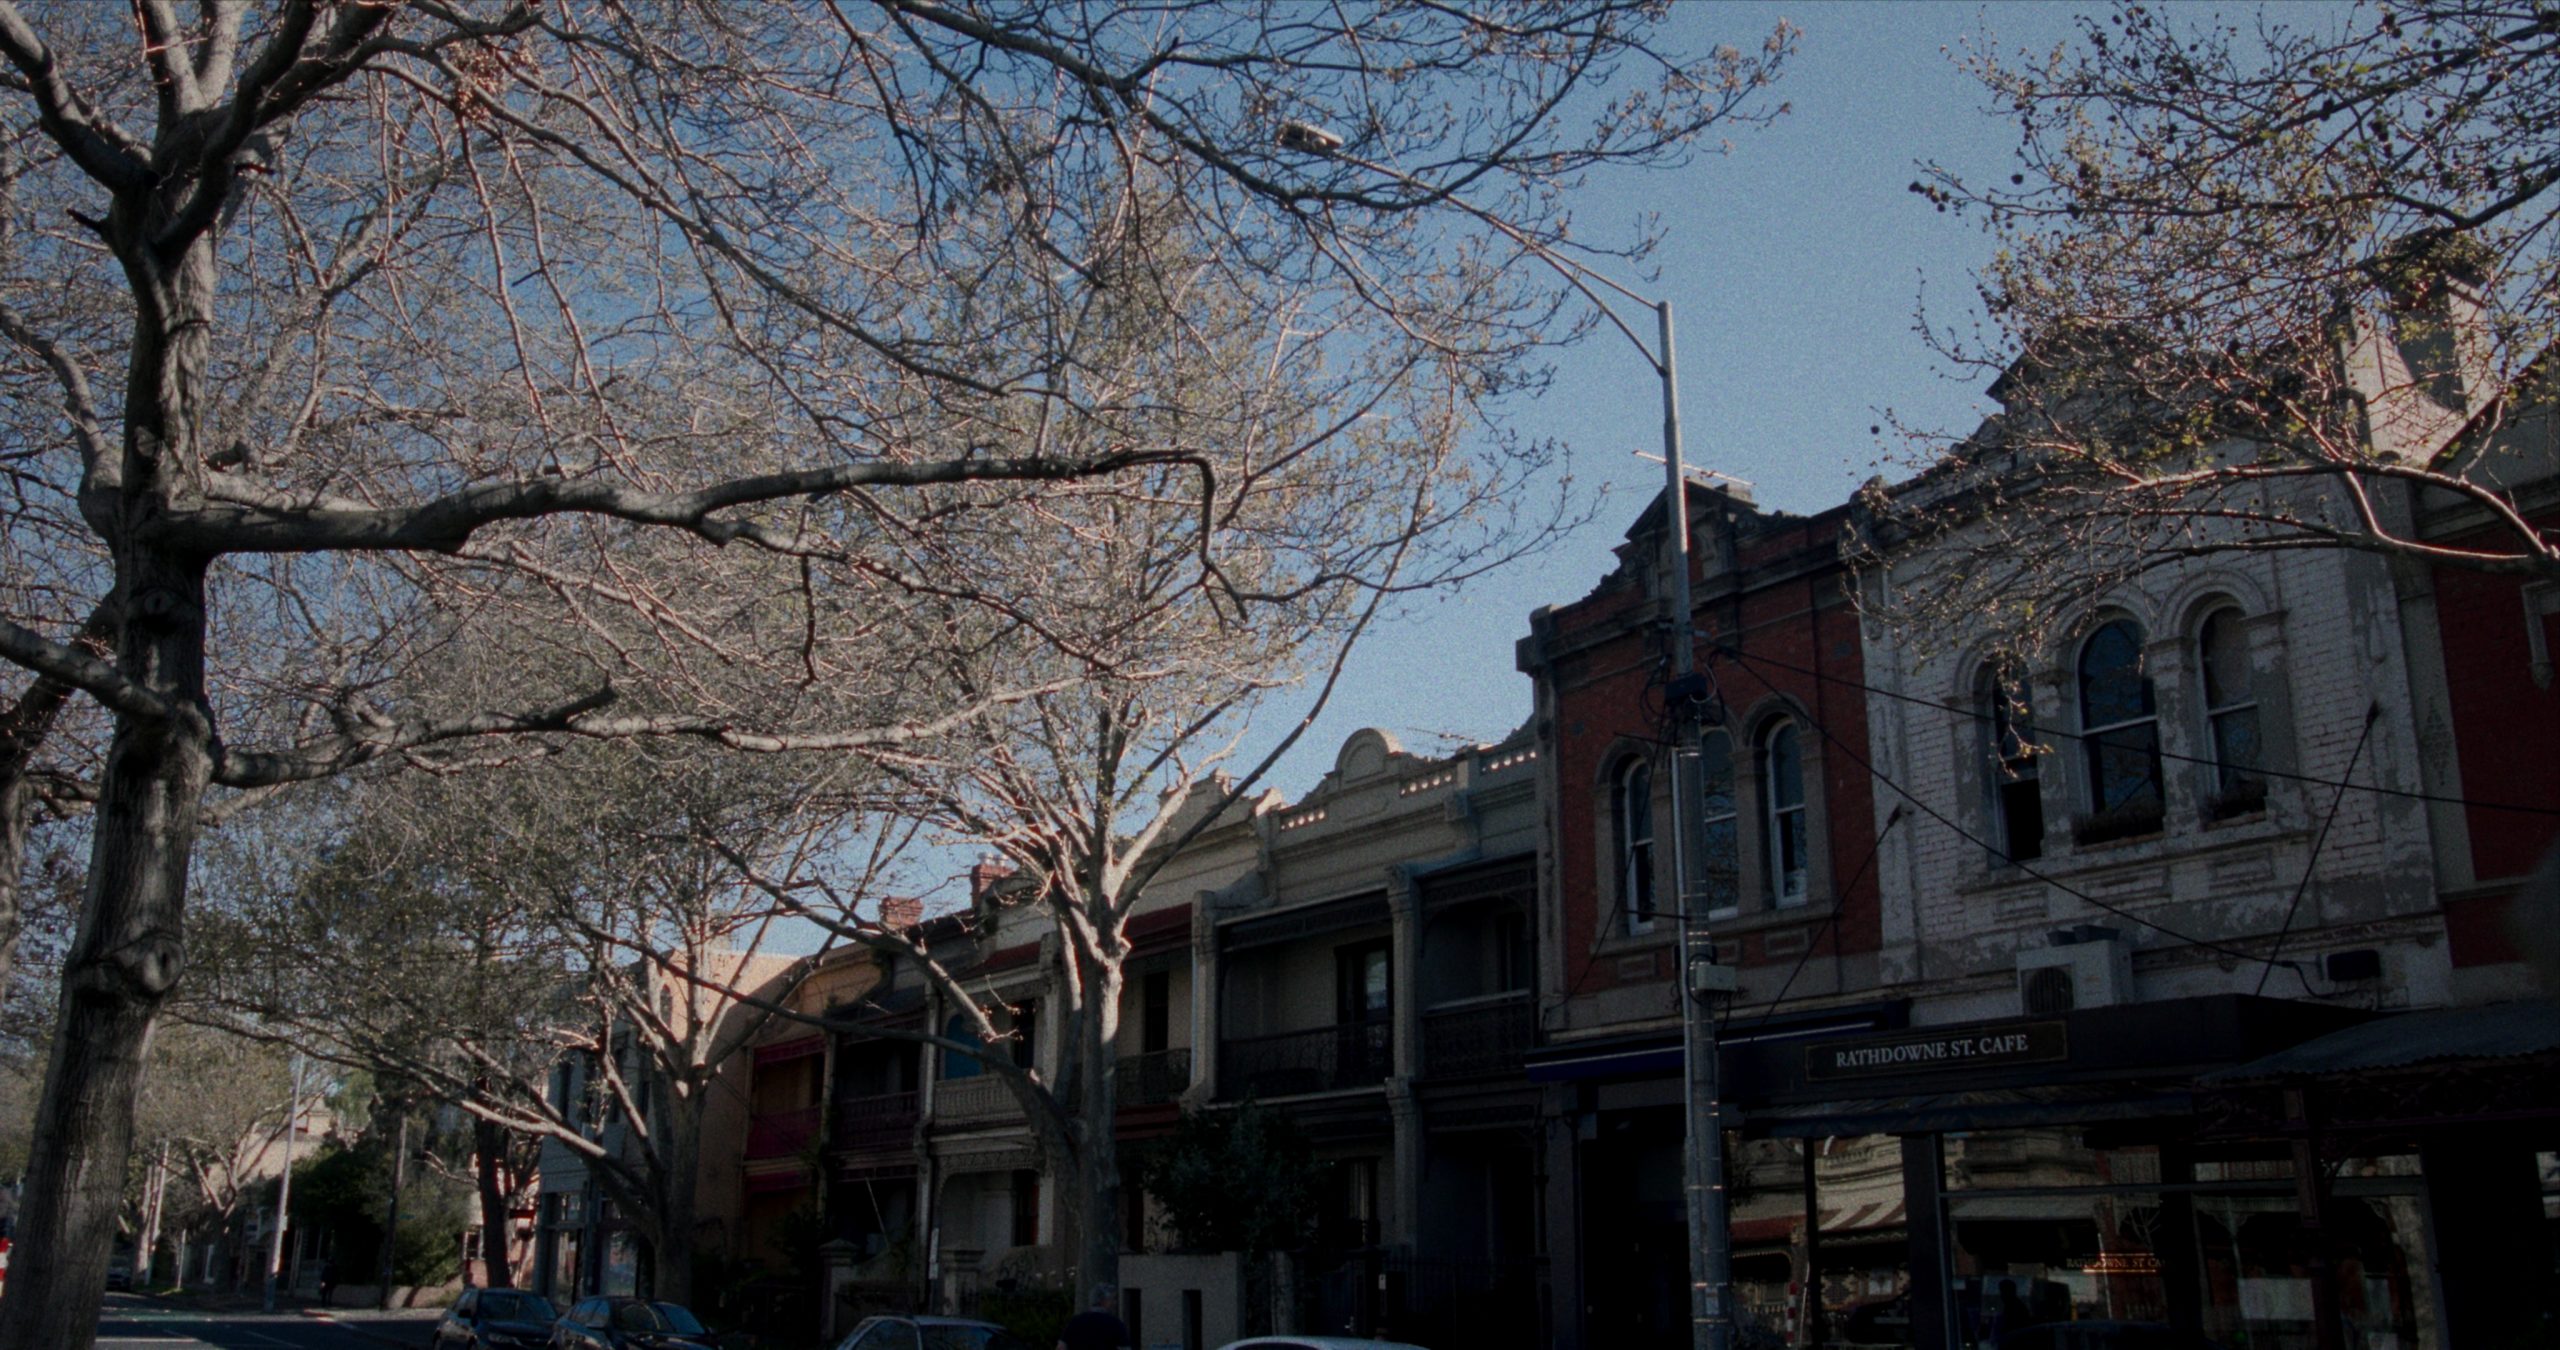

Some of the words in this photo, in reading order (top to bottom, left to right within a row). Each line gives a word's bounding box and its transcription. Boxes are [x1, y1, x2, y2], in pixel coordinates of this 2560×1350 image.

[1835, 1041, 1947, 1069] RATHDOWNE
[1951, 1038, 1976, 1057] ST.
[1979, 1034, 2029, 1055] CAFE
